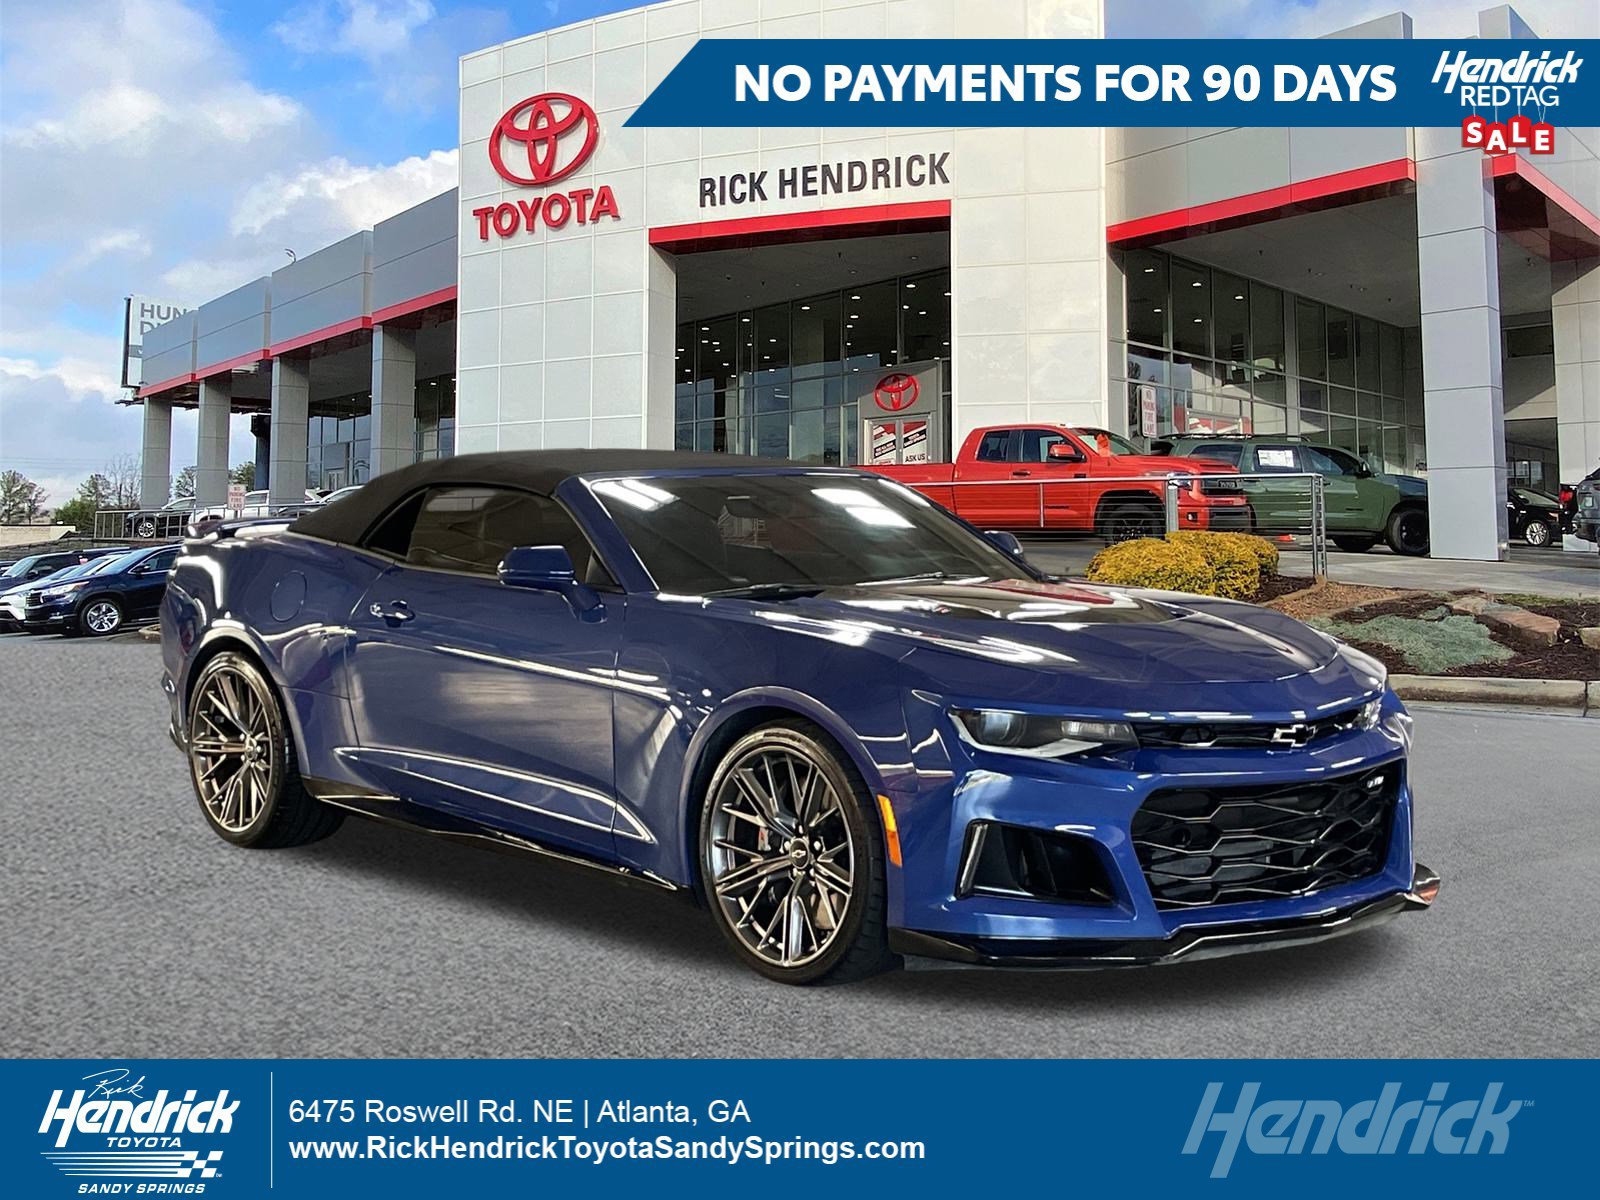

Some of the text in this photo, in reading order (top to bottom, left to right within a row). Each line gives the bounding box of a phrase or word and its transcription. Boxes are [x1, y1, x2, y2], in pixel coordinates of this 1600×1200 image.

[699, 152, 951, 208] RICK HENDRICK
[473, 185, 620, 240] TOYOTA
[905, 455, 917, 463] ASK
